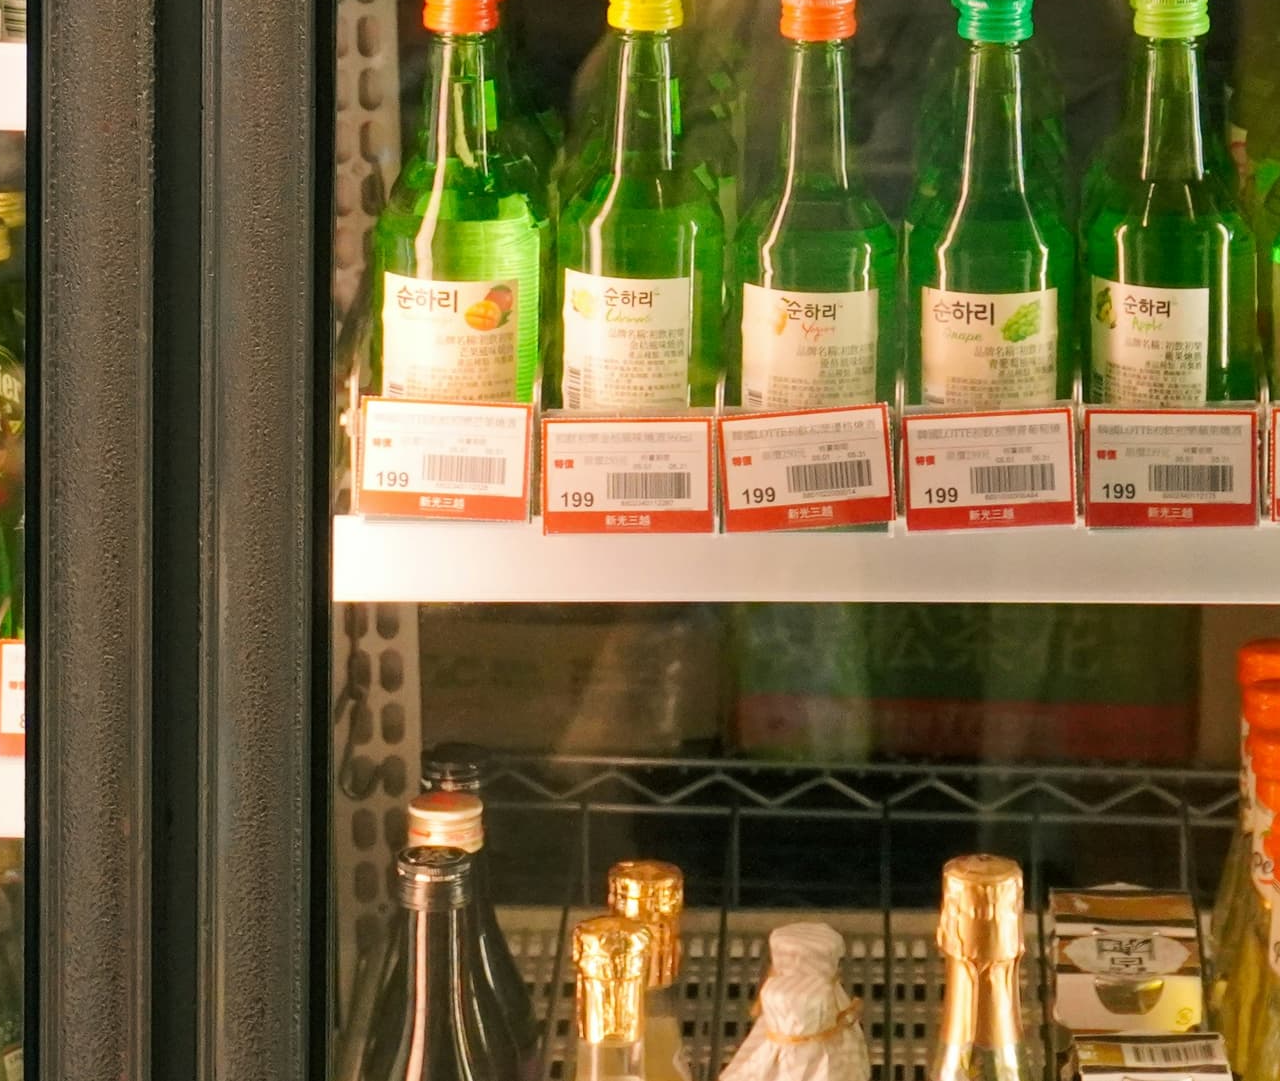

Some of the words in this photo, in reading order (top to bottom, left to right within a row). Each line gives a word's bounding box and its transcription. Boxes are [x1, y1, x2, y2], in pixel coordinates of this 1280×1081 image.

[396, 283, 459, 313] 순하리
[603, 286, 653, 309] 순하리
[1123, 294, 1172, 318] 순하리
[785, 300, 838, 321] 순하리
[932, 299, 995, 326] 순하리
[375, 471, 410, 488] 199
[560, 490, 595, 508] 199
[741, 486, 777, 505] 199
[924, 486, 959, 505] 199
[1101, 482, 1137, 500] 199
[419, 496, 465, 510] 新光三越
[604, 514, 651, 528] 新光三越
[787, 507, 834, 520] 新光三越
[969, 508, 1015, 521] 新光三越
[1147, 506, 1194, 520] 新光三越
